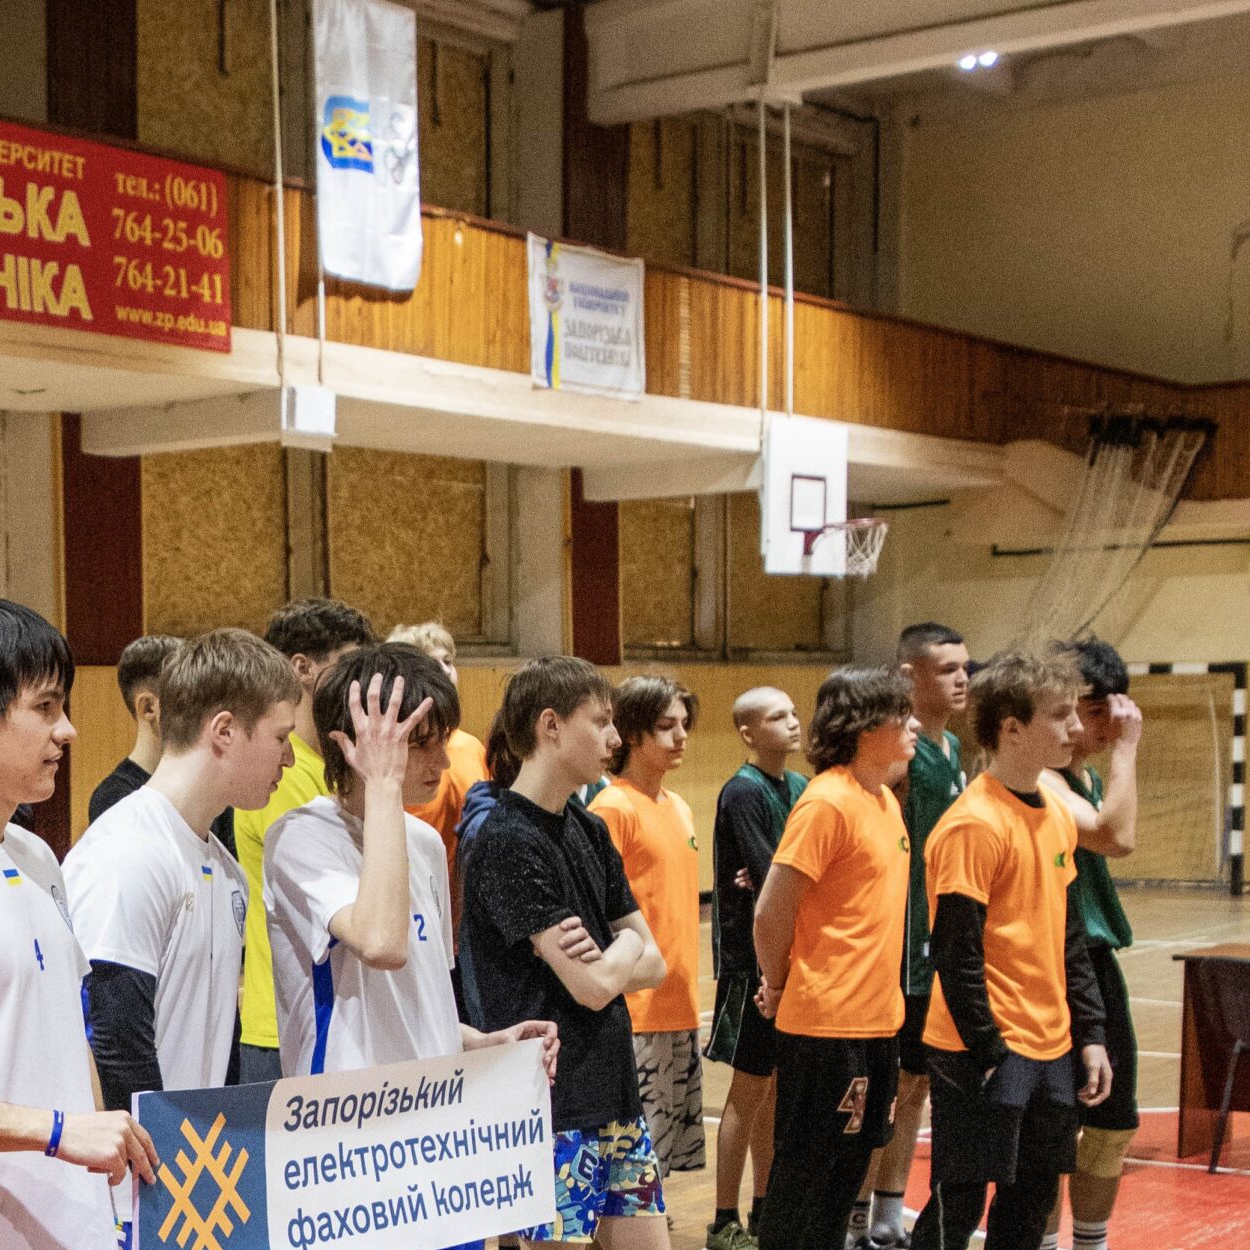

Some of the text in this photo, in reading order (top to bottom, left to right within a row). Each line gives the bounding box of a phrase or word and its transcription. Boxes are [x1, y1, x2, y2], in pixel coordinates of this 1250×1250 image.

[165, 173, 218, 219] (061)
[111, 207, 224, 259] 764-25-06
[112, 255, 223, 305] 764-21-41
[115, 305, 228, 337] www.zp.edu.ua
[413, 914, 428, 942] 2
[283, 1069, 465, 1132] Запорізький
[837, 1076, 869, 1135] 4
[284, 1108, 545, 1190] електротехнічний
[431, 1163, 534, 1217] коледж
